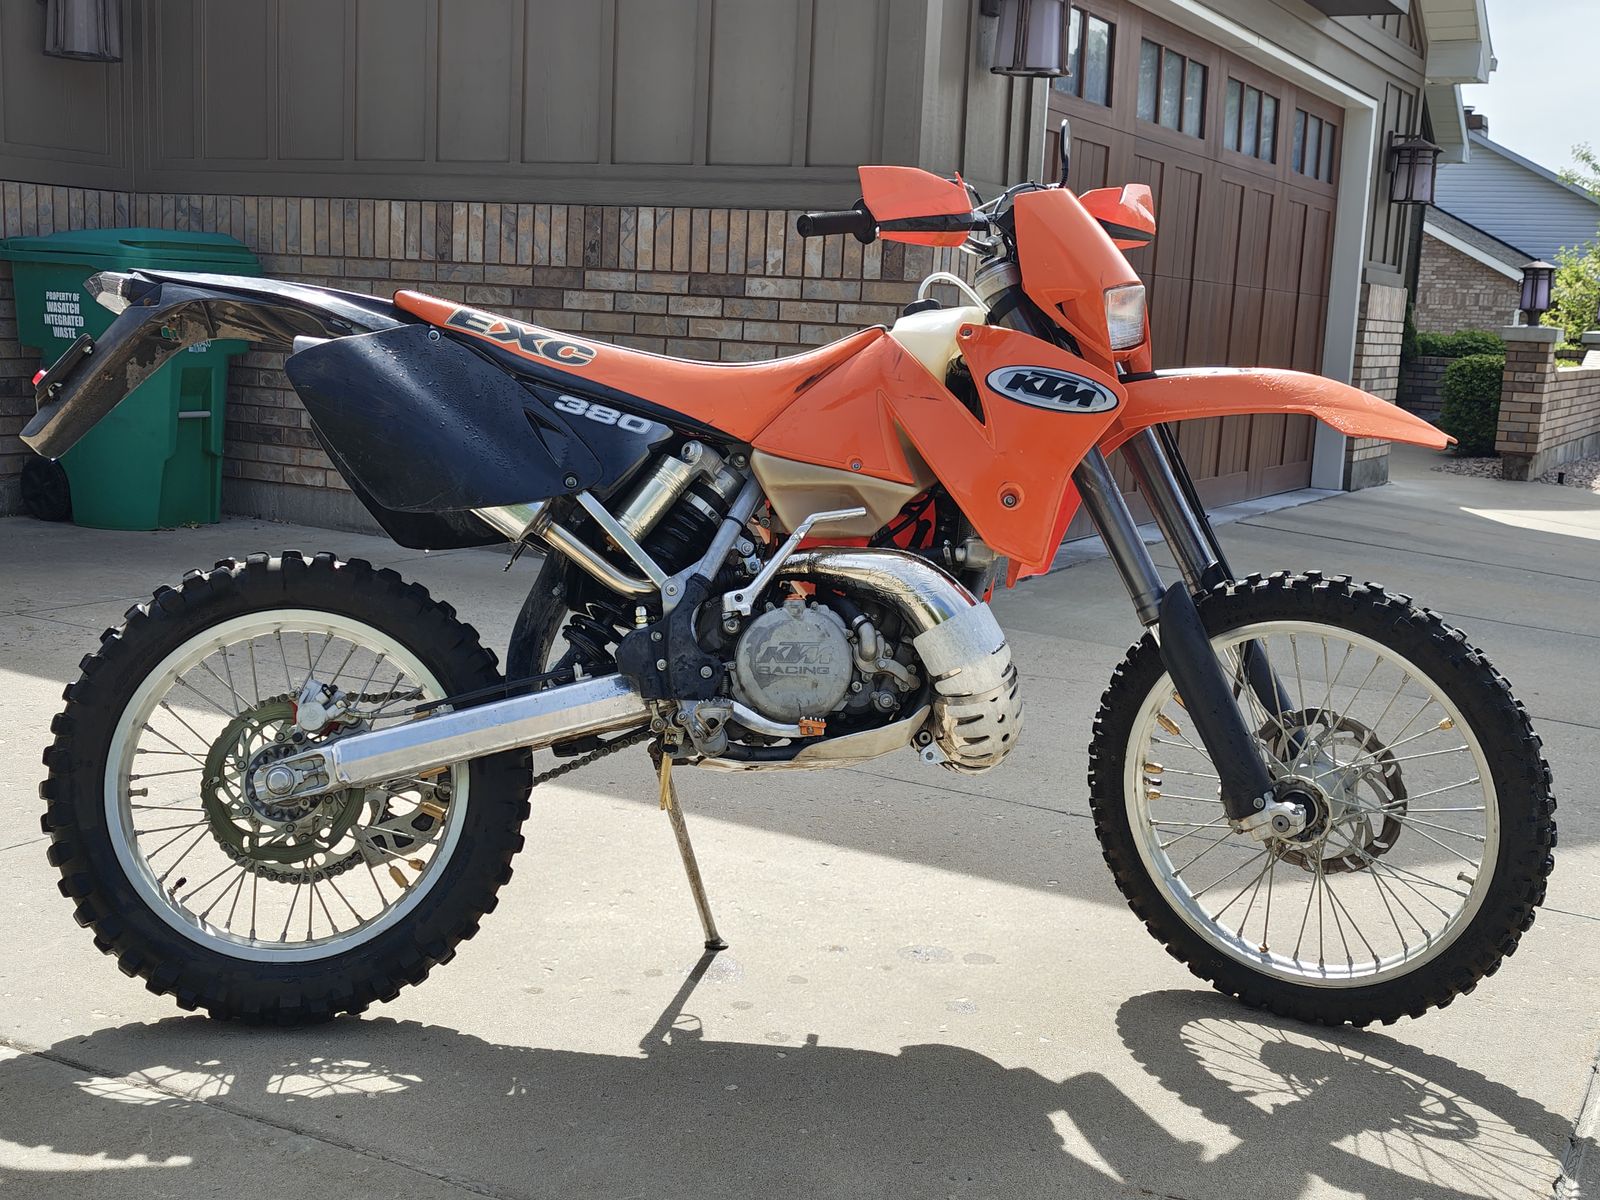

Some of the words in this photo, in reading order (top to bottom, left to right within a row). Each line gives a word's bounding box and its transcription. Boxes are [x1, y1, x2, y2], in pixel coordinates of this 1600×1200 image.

[46, 291, 72, 301] PROPERTY
[72, 293, 80, 302] OF
[46, 301, 80, 315] WASATCH
[44, 313, 84, 327] INTEGRATED
[52, 326, 77, 339] WASTE
[444, 308, 597, 366] EXC
[1005, 371, 1097, 408] KTM
[553, 395, 652, 434] 380
[757, 641, 834, 665] KTM
[756, 665, 831, 675] RACING
